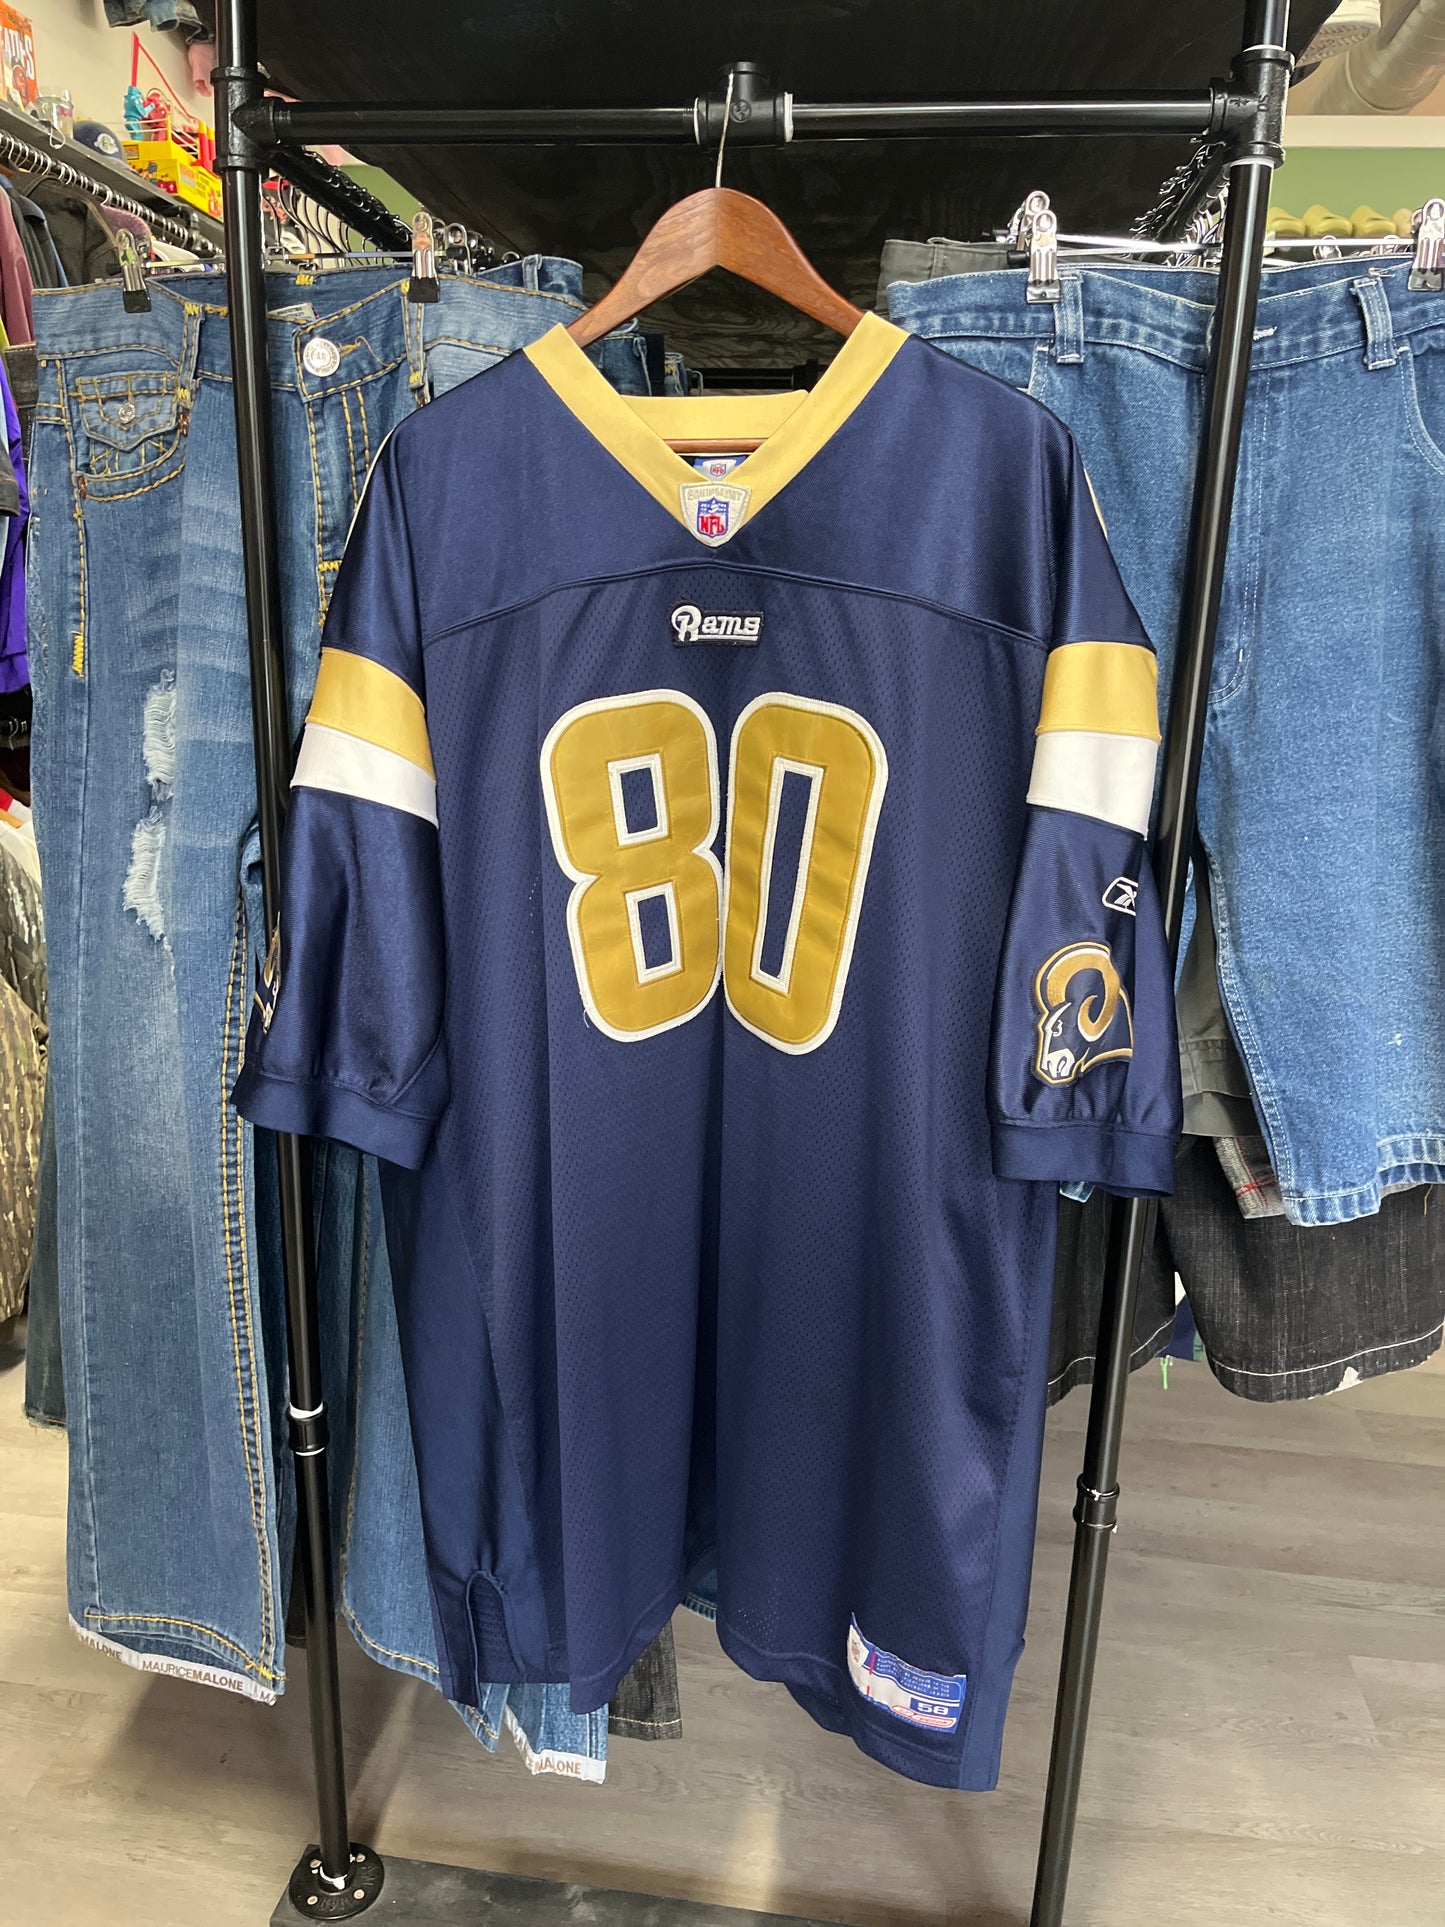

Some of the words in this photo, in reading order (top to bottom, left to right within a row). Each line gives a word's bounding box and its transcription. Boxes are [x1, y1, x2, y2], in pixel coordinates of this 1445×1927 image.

[698, 514, 726, 535] NFL
[671, 605, 761, 642] Rams
[540, 688, 888, 1056] 80
[917, 1702, 949, 1716] 58
